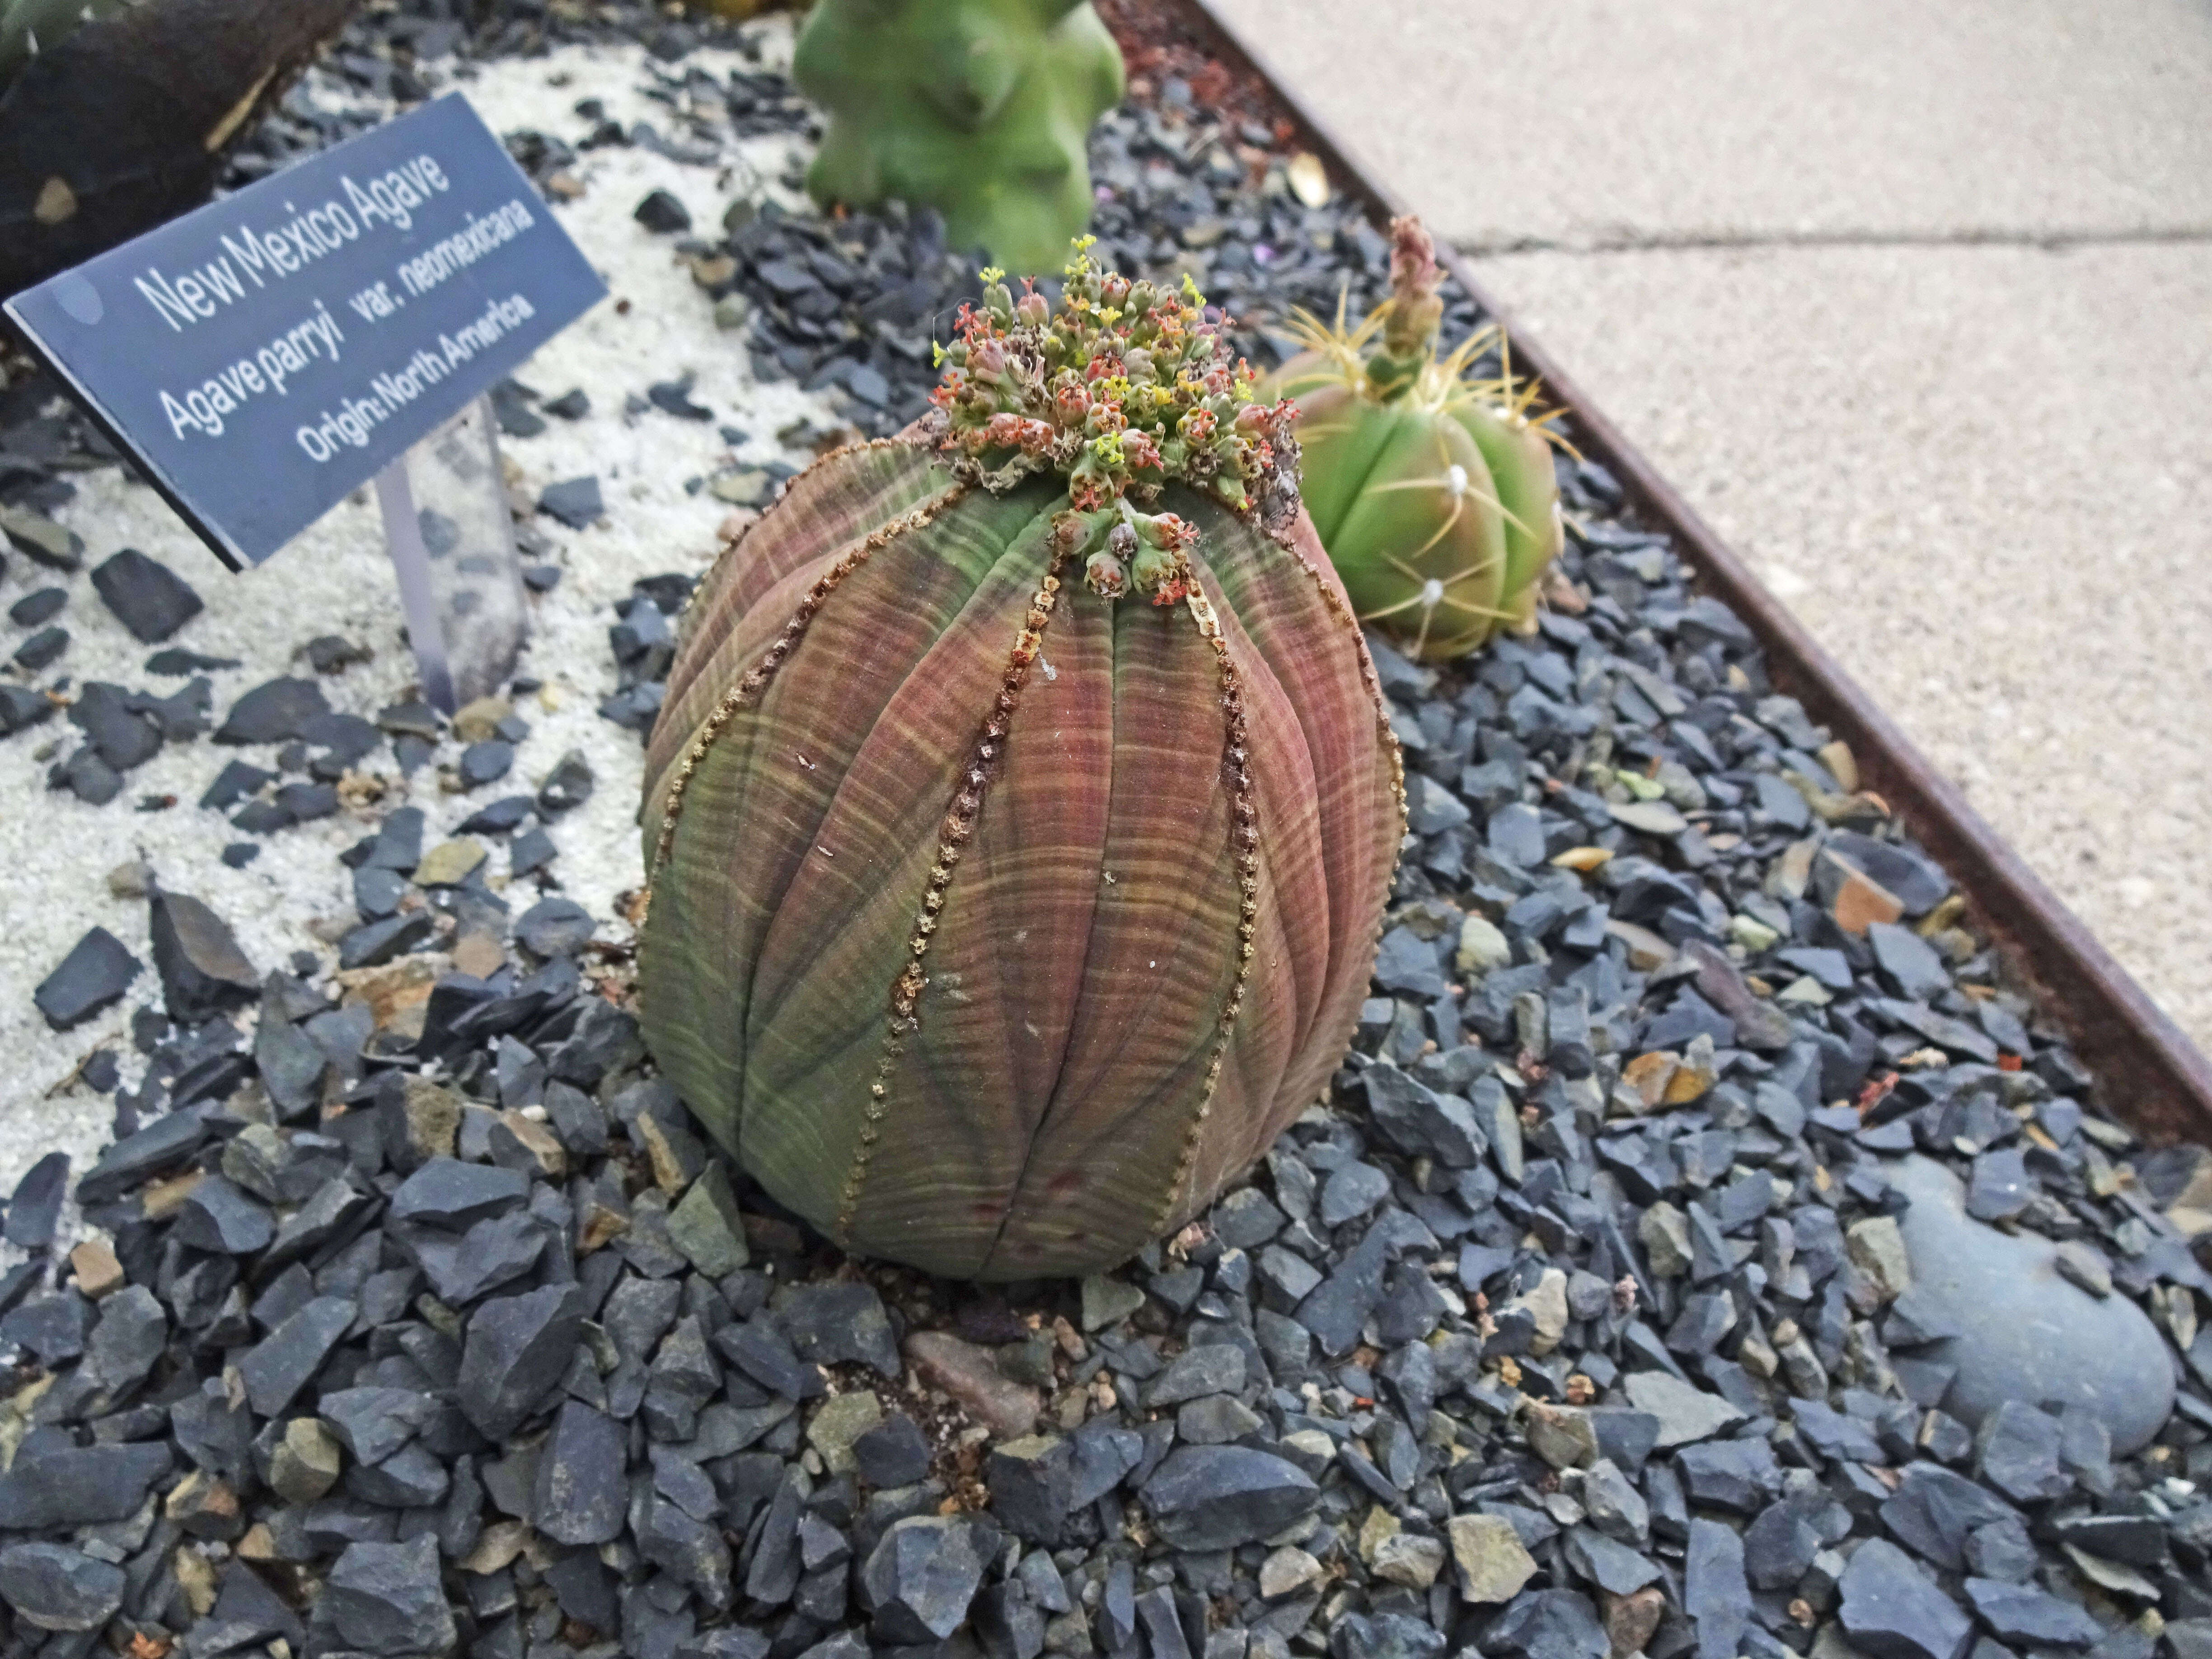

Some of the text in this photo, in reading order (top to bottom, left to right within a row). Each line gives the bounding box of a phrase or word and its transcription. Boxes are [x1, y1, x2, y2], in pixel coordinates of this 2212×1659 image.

[134, 155, 449, 332] New Mexico Agave
[158, 199, 534, 441] Agave parryi var. neomexicana
[296, 294, 535, 462] Origin: North America
